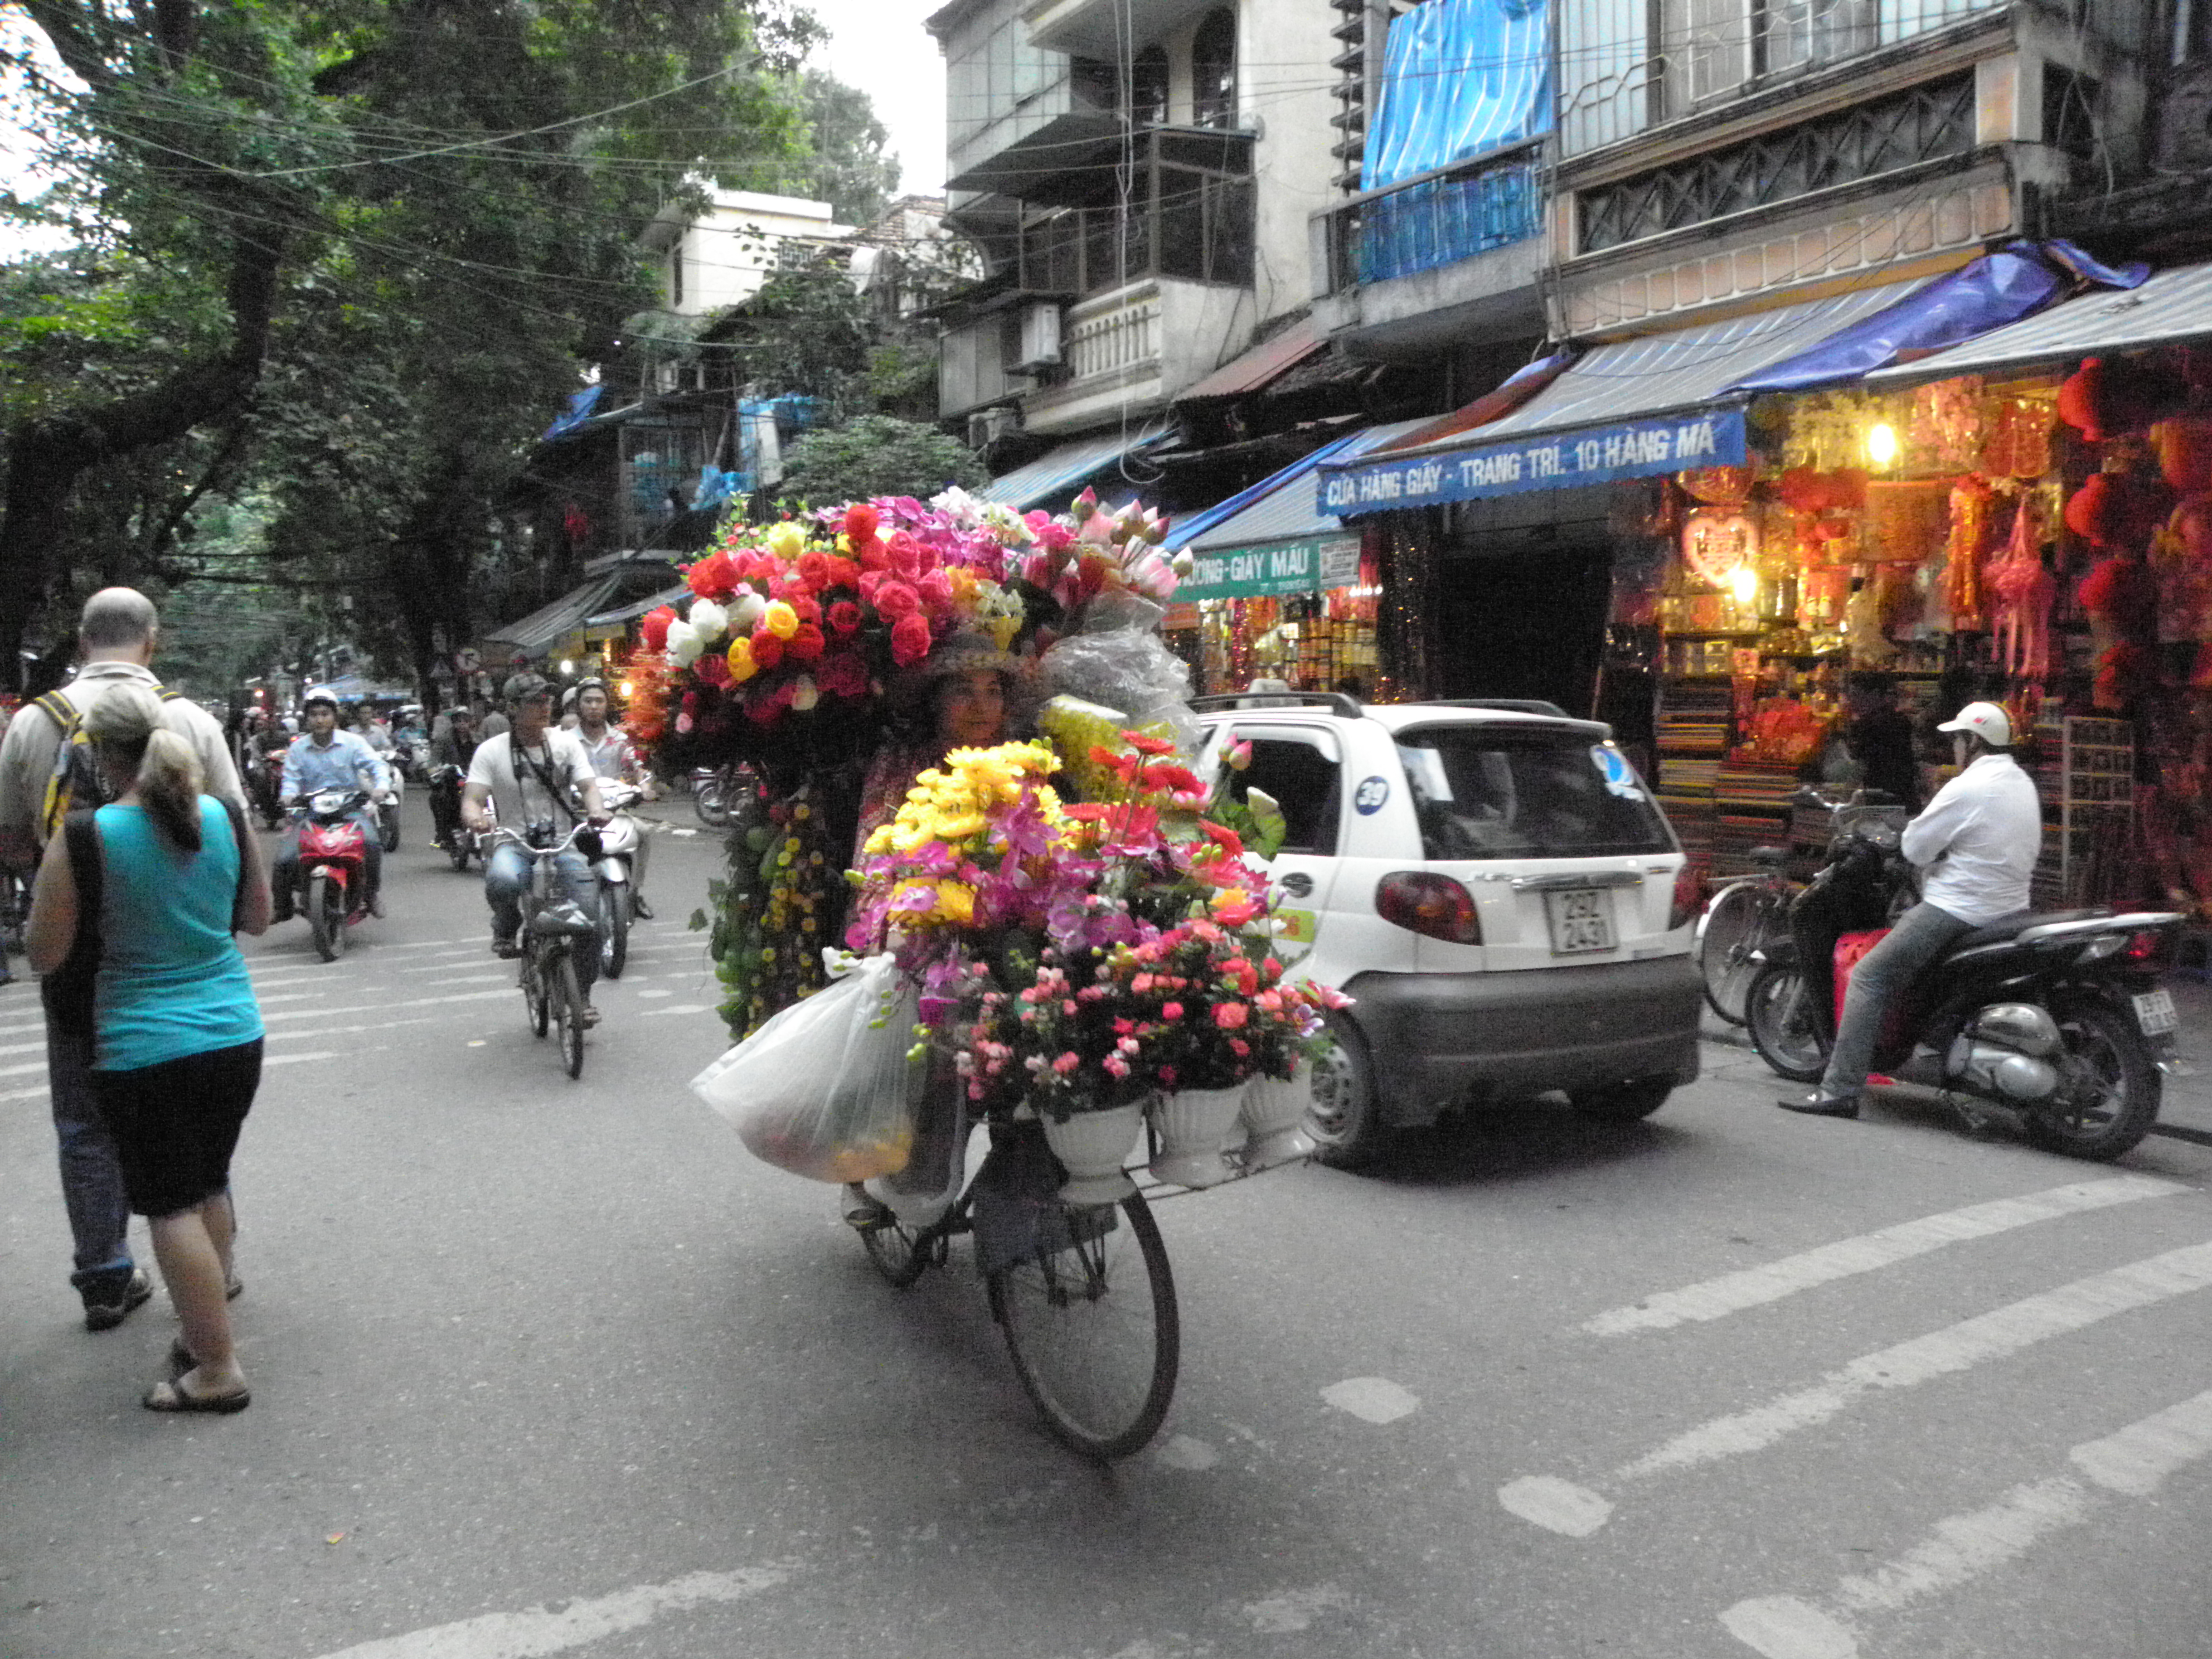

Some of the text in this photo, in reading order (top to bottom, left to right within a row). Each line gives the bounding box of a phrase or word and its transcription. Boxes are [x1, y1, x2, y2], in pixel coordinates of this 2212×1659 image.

[1361, 469, 1401, 502] HÀNG
[1406, 457, 1443, 495] GIẤY
[1459, 452, 1521, 488] TRANG
[1575, 440, 1599, 471] 10
[1605, 426, 1671, 468] HÀNG
[1676, 415, 1716, 458] MÃ
